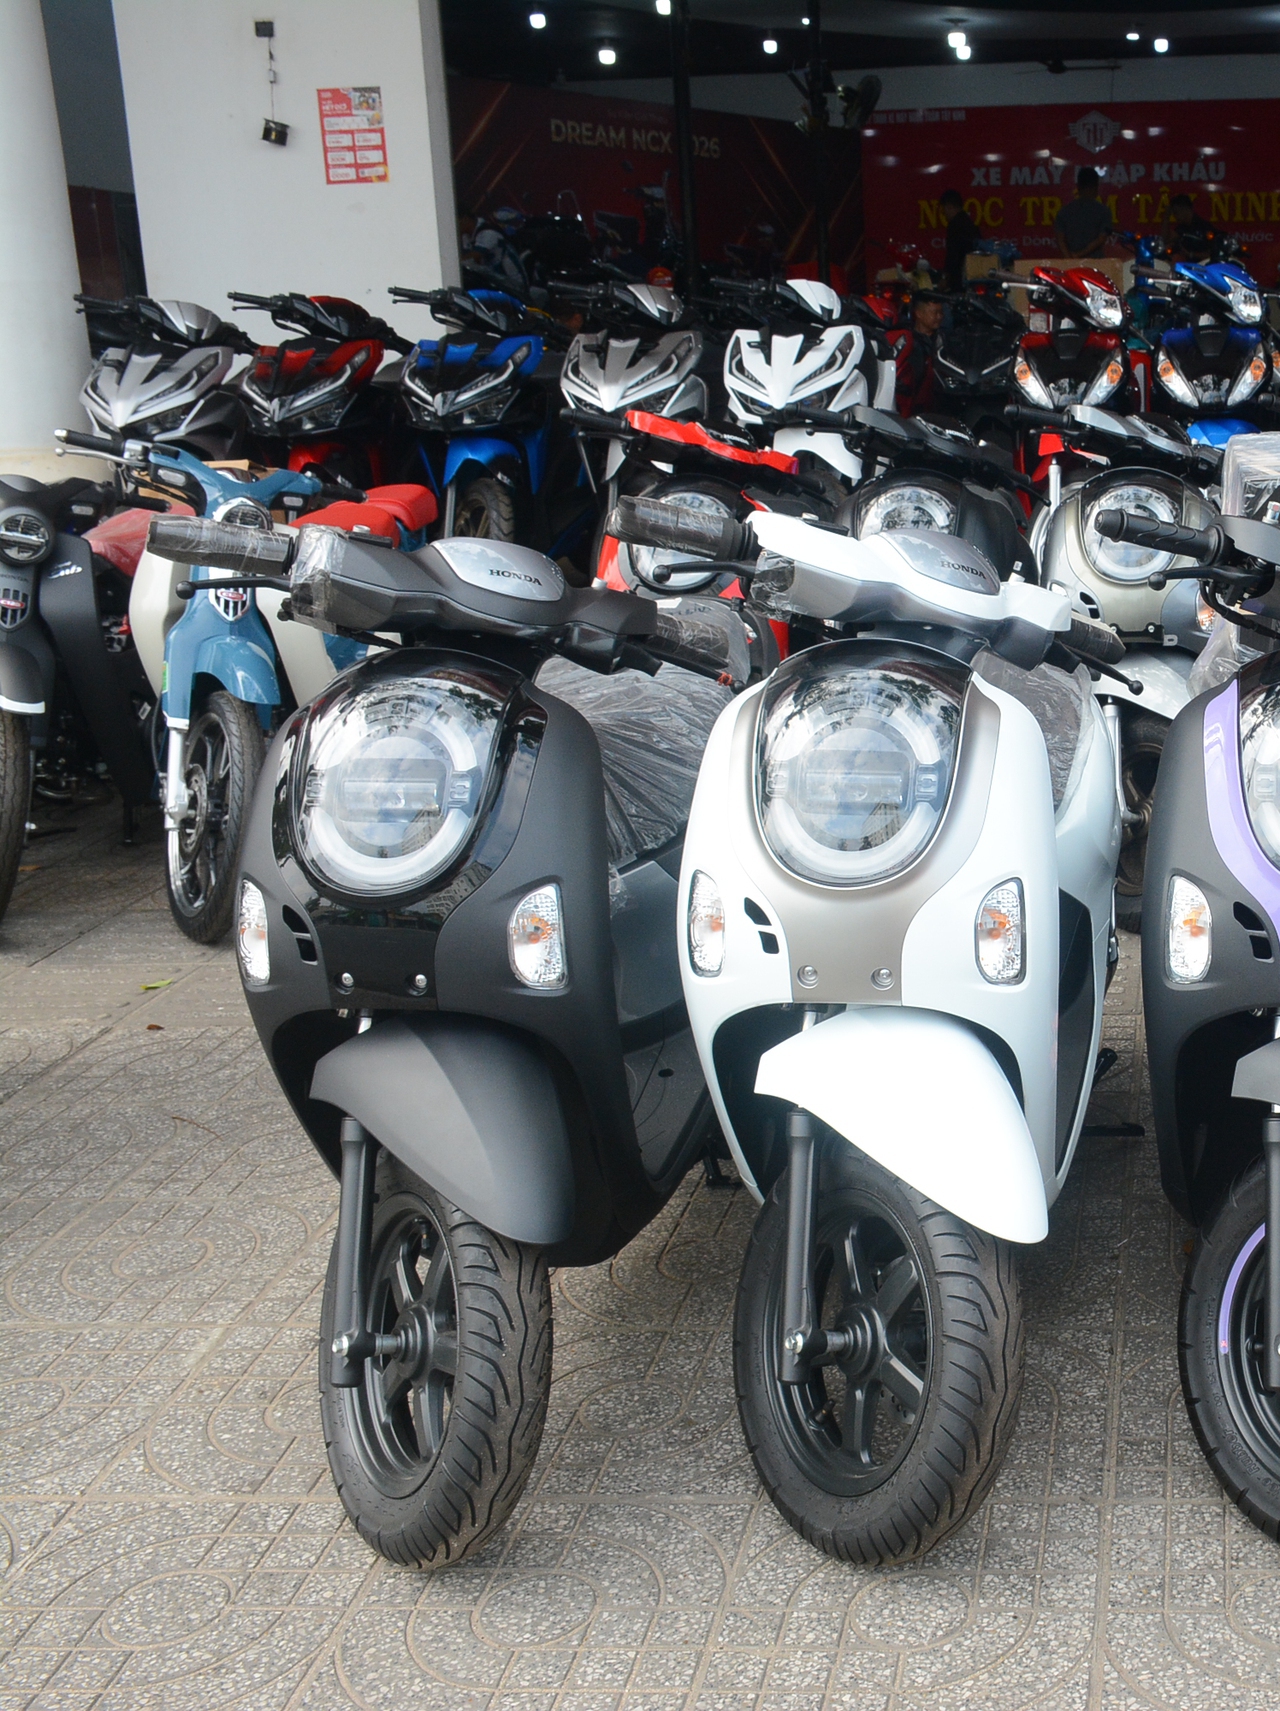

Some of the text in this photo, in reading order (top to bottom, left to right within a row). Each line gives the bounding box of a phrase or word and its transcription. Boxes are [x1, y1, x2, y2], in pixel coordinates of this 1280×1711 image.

[550, 118, 627, 150] DREAM
[632, 127, 674, 154] NCX
[970, 166, 1002, 187] XE
[1009, 160, 1066, 186] MÁY
[488, 568, 543, 587] HONDA
[939, 560, 987, 580] HONDA
